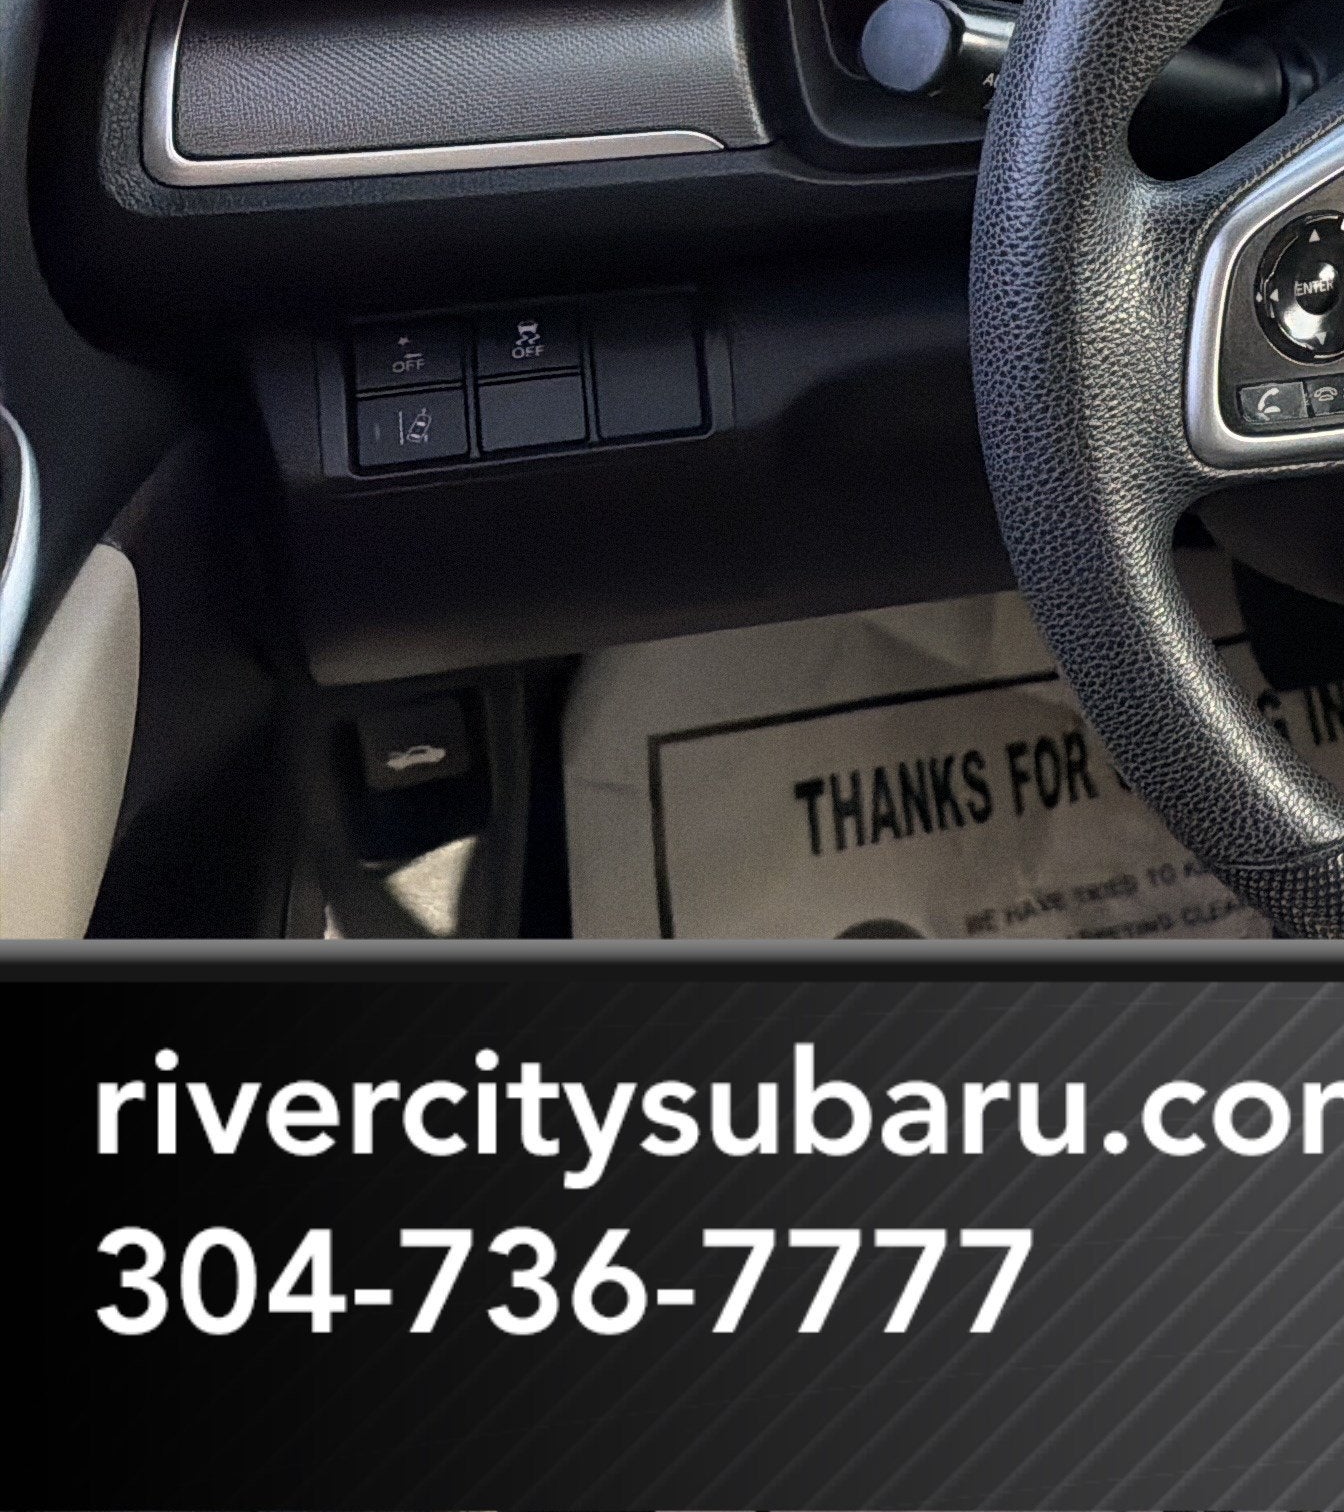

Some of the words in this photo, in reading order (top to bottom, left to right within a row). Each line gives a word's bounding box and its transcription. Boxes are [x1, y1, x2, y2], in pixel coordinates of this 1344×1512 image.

[1294, 280, 1335, 297] ENTER
[512, 343, 546, 360] OFF
[391, 358, 426, 374] OFF
[794, 750, 993, 856] THANKS
[1006, 730, 1099, 818] FOR
[1147, 862, 1178, 885] TO
